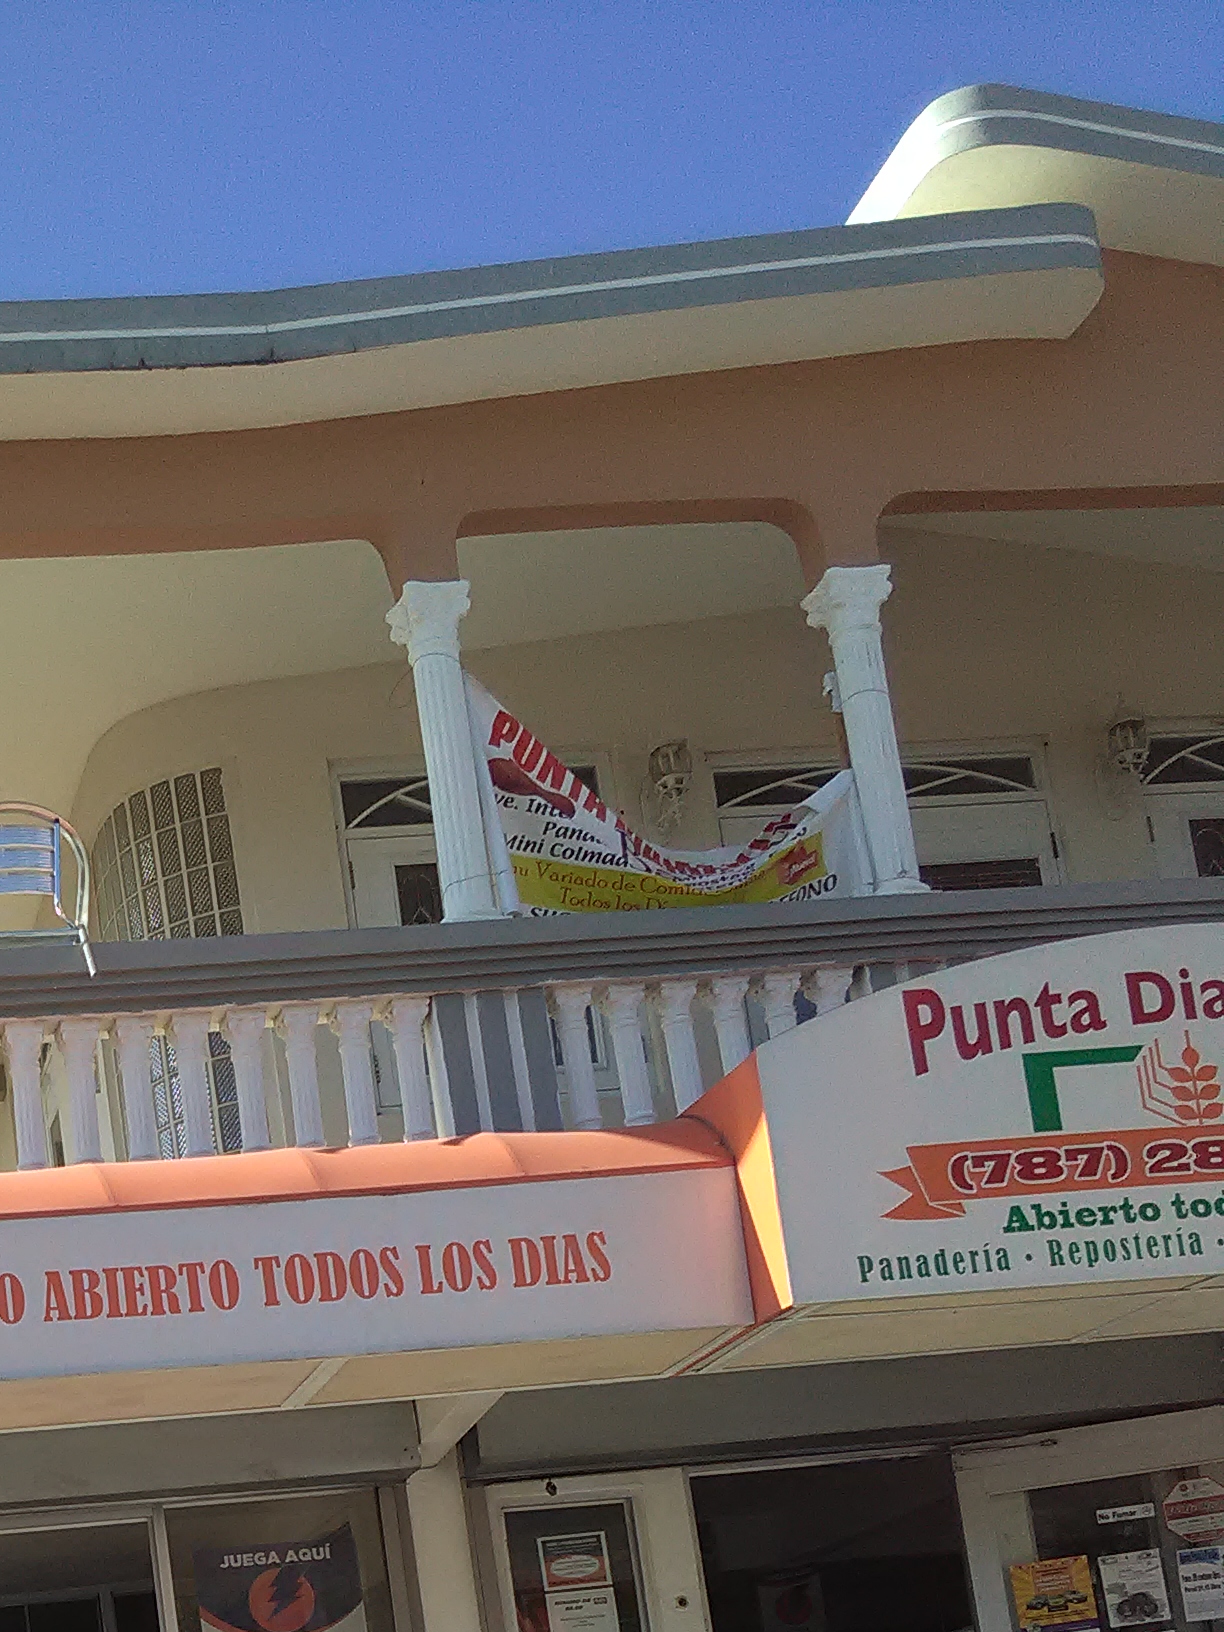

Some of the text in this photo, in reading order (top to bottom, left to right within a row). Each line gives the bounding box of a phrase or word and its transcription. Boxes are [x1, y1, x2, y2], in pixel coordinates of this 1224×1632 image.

[536, 860, 608, 888] Variado
[612, 872, 635, 891] de
[560, 886, 610, 909] Todos
[616, 895, 640, 911] los
[902, 981, 1107, 1077] Punta
[948, 1136, 1224, 1194] (787) 28
[1003, 1196, 1161, 1234] Abierto
[857, 1226, 1204, 1283] Panadería Repostería
[43, 1259, 240, 1322] ABIERTO
[254, 1246, 405, 1307] TODOS
[414, 1238, 498, 1295] LOS
[508, 1230, 612, 1288] DIAS
[1098, 1513, 1110, 1521] No
[219, 1550, 282, 1569] JUEGA
